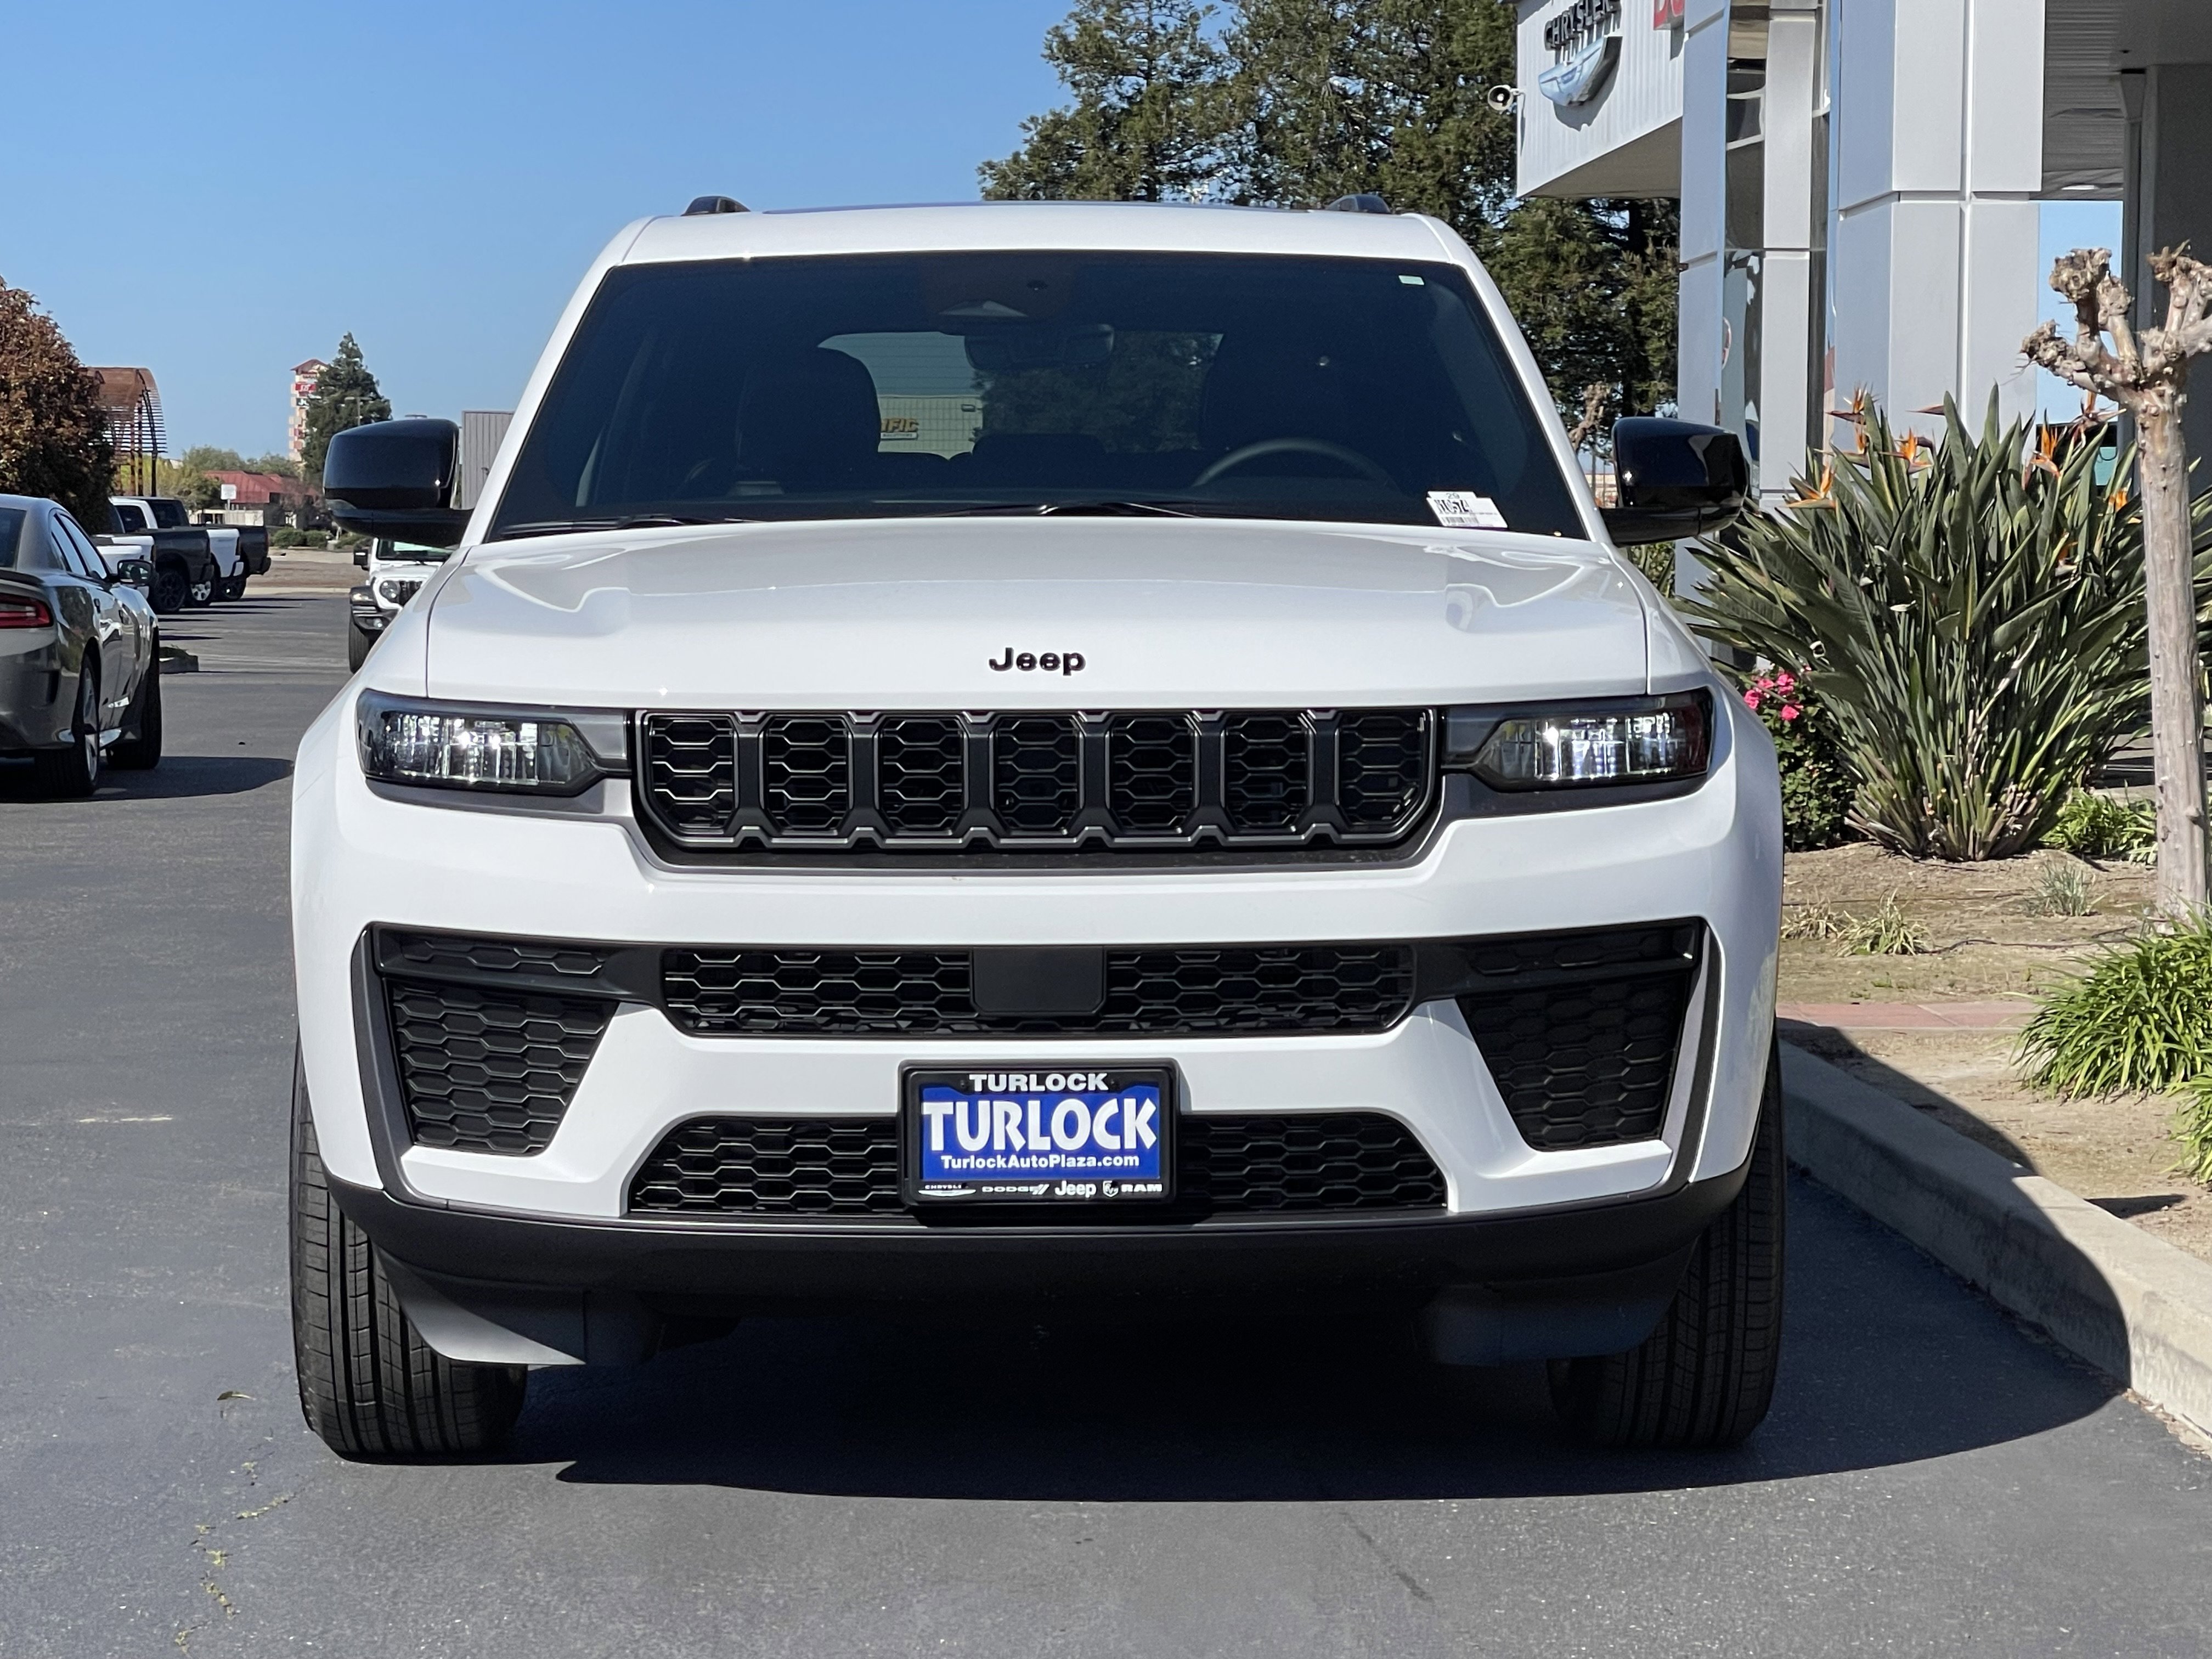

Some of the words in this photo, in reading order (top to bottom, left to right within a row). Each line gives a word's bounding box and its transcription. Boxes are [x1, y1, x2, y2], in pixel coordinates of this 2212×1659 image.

[988, 647, 1086, 676] Jeep
[969, 1073, 1109, 1092] TURLOCK
[922, 1097, 1158, 1152] TURLOCK
[940, 1154, 1139, 1169] TurlockAutoPlaza.com
[1054, 1180, 1097, 1198] Jeep
[1121, 1184, 1163, 1192] RAM
